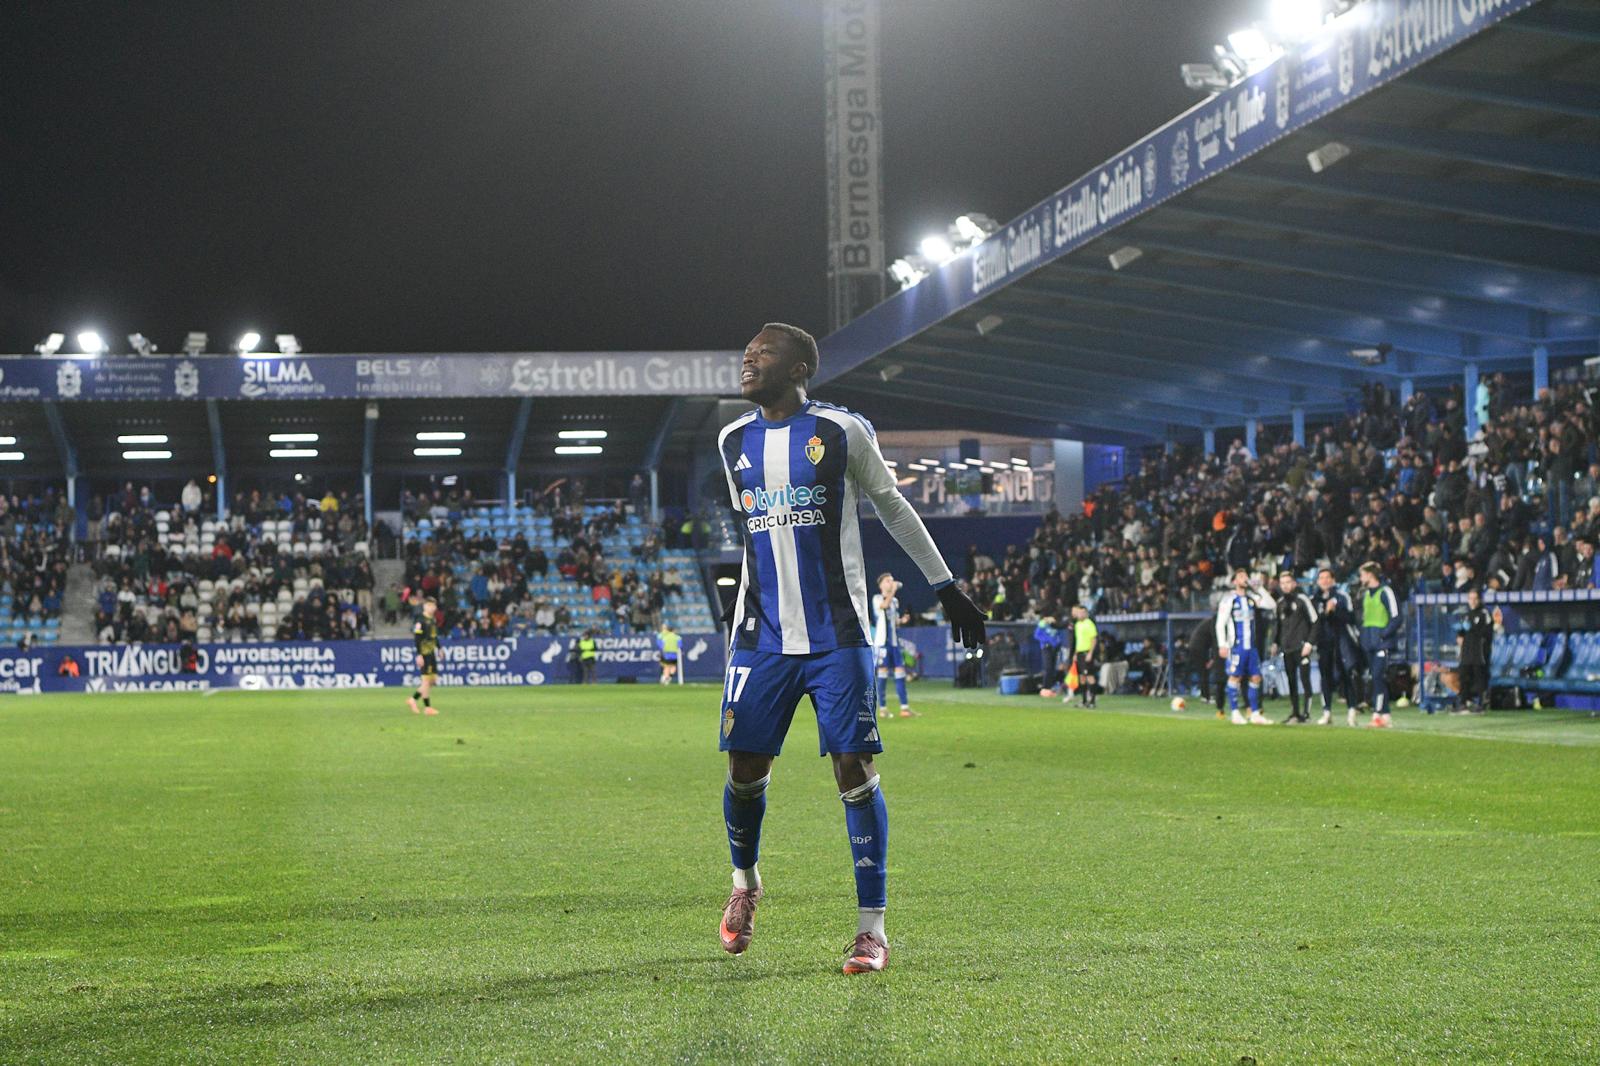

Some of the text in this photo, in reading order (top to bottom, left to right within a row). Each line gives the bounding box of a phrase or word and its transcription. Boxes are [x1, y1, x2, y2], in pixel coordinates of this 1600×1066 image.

[842, 87, 876, 269] Bernesga
[242, 361, 313, 383] SILMA
[355, 360, 412, 375] BELS
[509, 356, 740, 391] Estrella Galici
[357, 382, 443, 393] Inmobiliaria
[747, 509, 826, 534] CRICURSA
[84, 644, 210, 677] TRIÁNGUO
[214, 647, 335, 664] AUTOESCUELA
[466, 672, 523, 686] Galicia
[727, 666, 752, 703] 17
[851, 835, 873, 845] SDP
